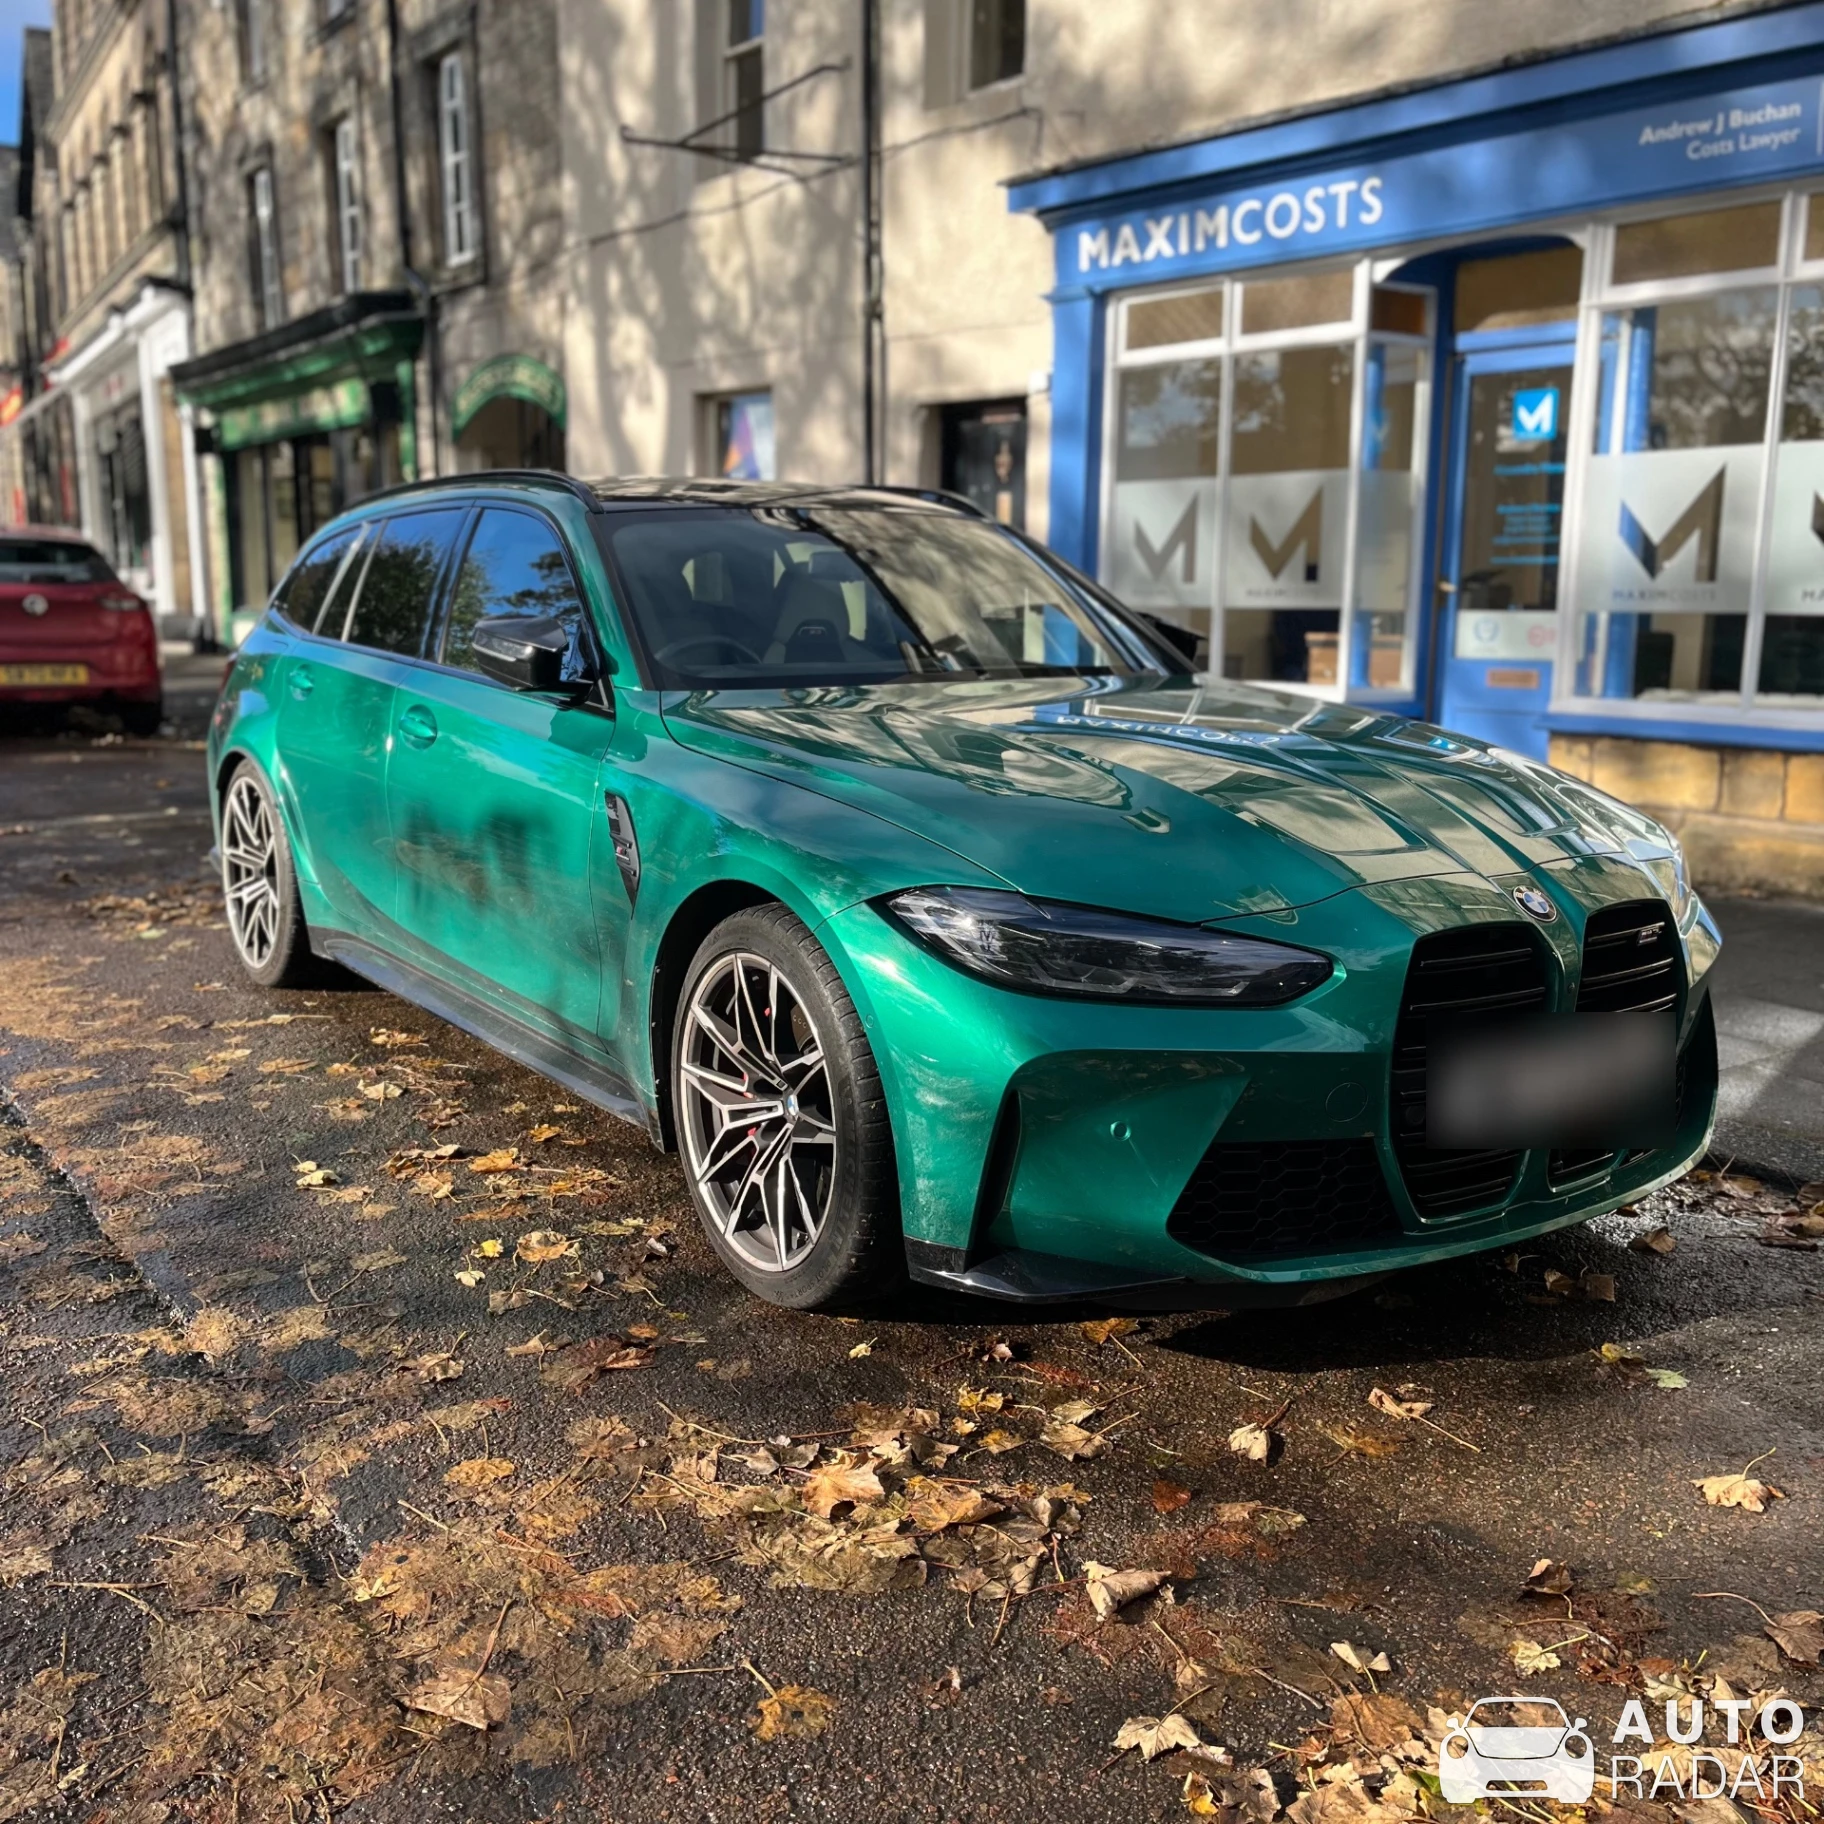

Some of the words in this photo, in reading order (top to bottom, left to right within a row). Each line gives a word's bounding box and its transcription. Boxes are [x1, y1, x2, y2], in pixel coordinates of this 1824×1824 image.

[1638, 119, 1713, 145] Andrew
[1714, 112, 1725, 135] J
[1729, 102, 1802, 129] Buchan
[1685, 139, 1736, 160] Costs
[1739, 127, 1801, 151] Lawyer
[1078, 177, 1384, 273] MAXIMCOSTS
